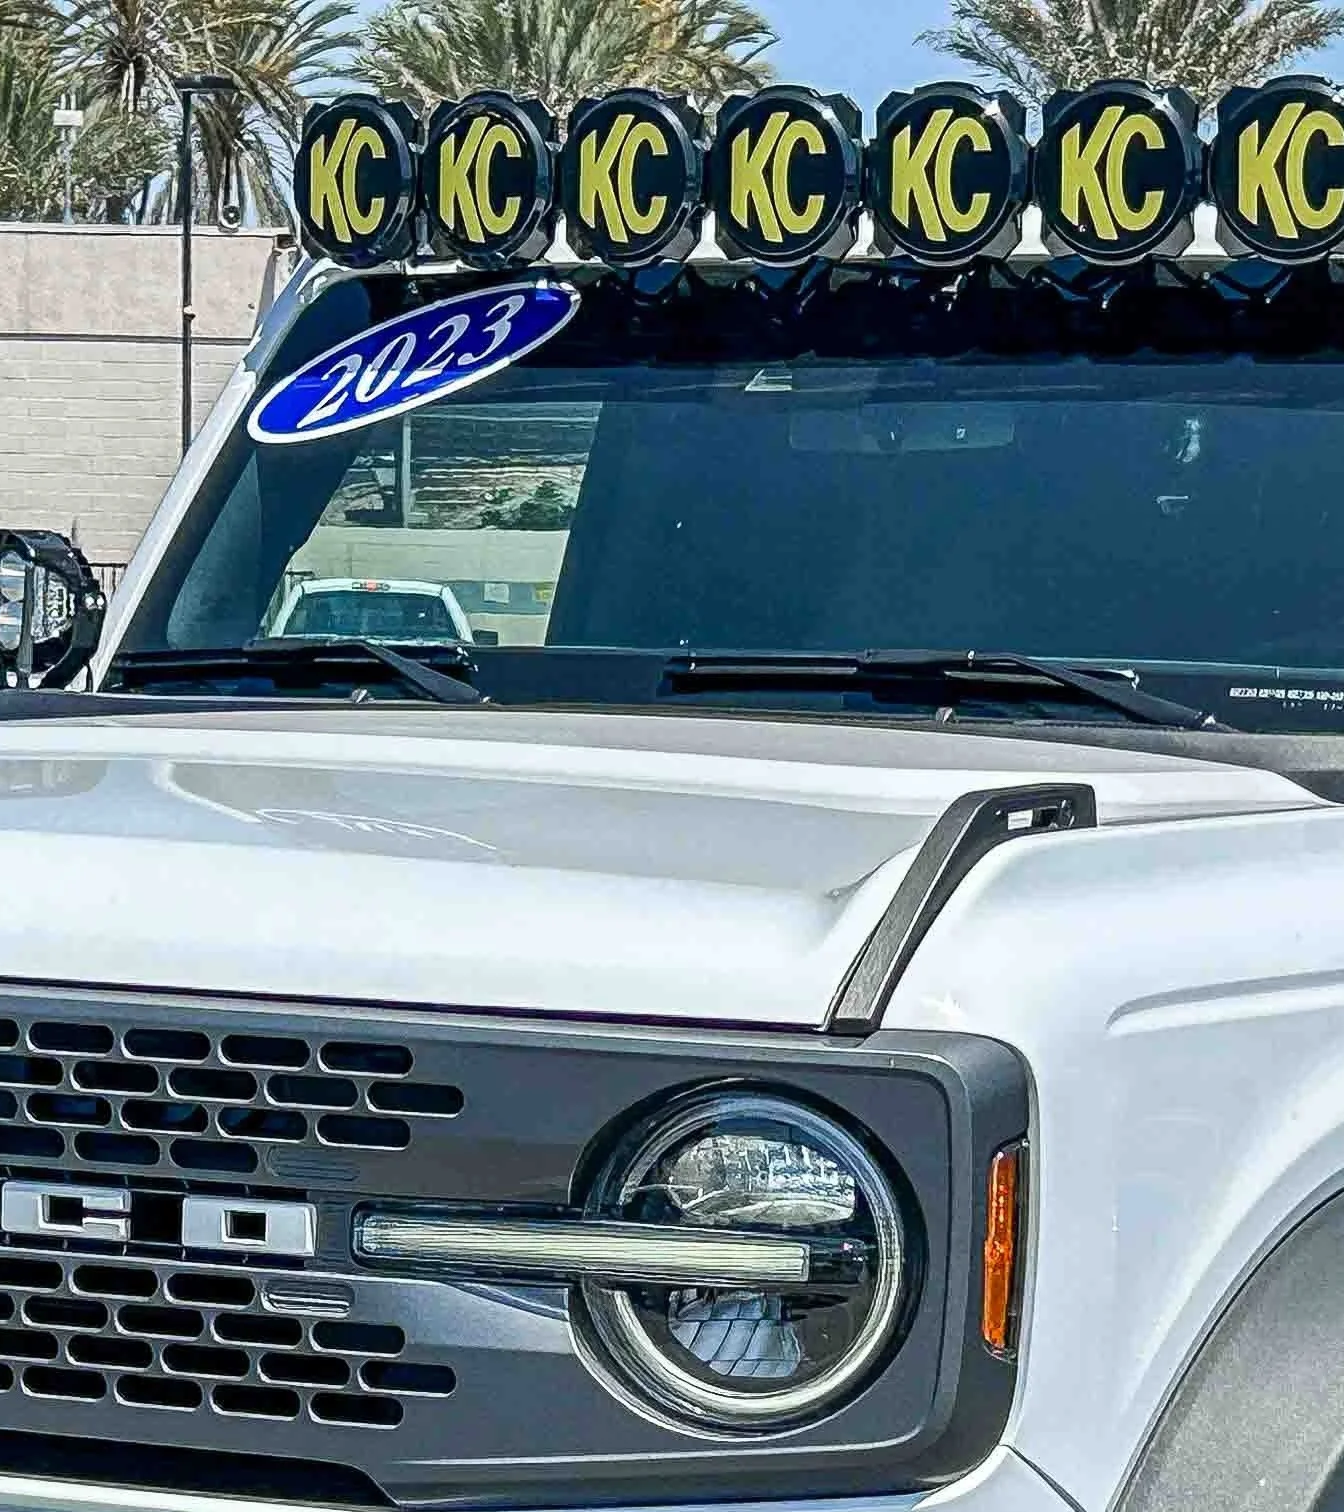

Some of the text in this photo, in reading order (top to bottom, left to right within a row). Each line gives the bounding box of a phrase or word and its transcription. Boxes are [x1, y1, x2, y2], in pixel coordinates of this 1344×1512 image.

[310, 117, 387, 244] KC
[440, 115, 522, 243] KC
[579, 112, 668, 243] KC
[730, 111, 827, 243] KC
[892, 107, 992, 242] KC
[1061, 104, 1166, 240] KC
[297, 294, 526, 429] 2023
